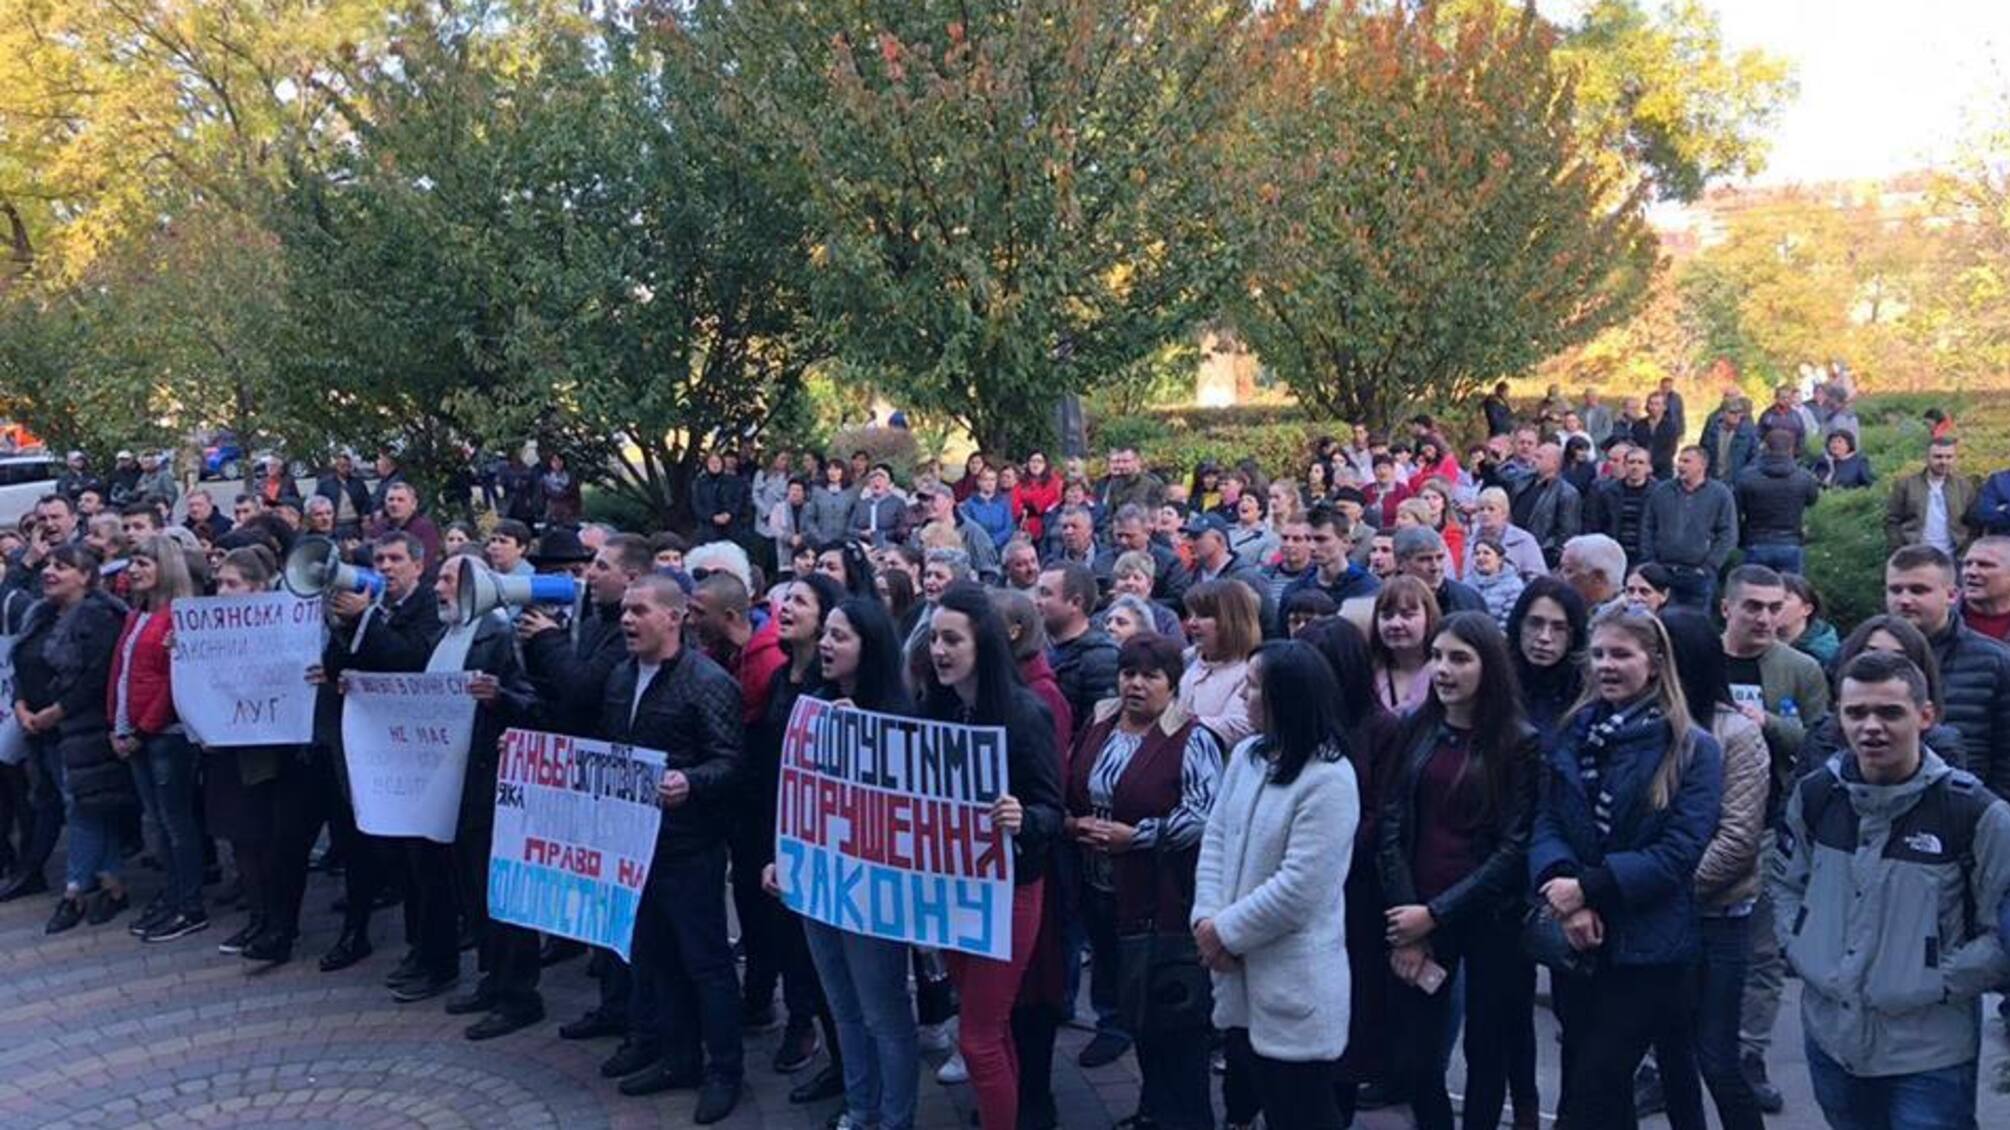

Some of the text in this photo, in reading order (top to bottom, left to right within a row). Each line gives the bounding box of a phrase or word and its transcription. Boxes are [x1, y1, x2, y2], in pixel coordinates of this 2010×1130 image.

[523, 837, 646, 888] ПРАВО НА
[780, 769, 1007, 881] ПОРУШЕННЯ
[779, 837, 993, 953] ЗАКОНУ
